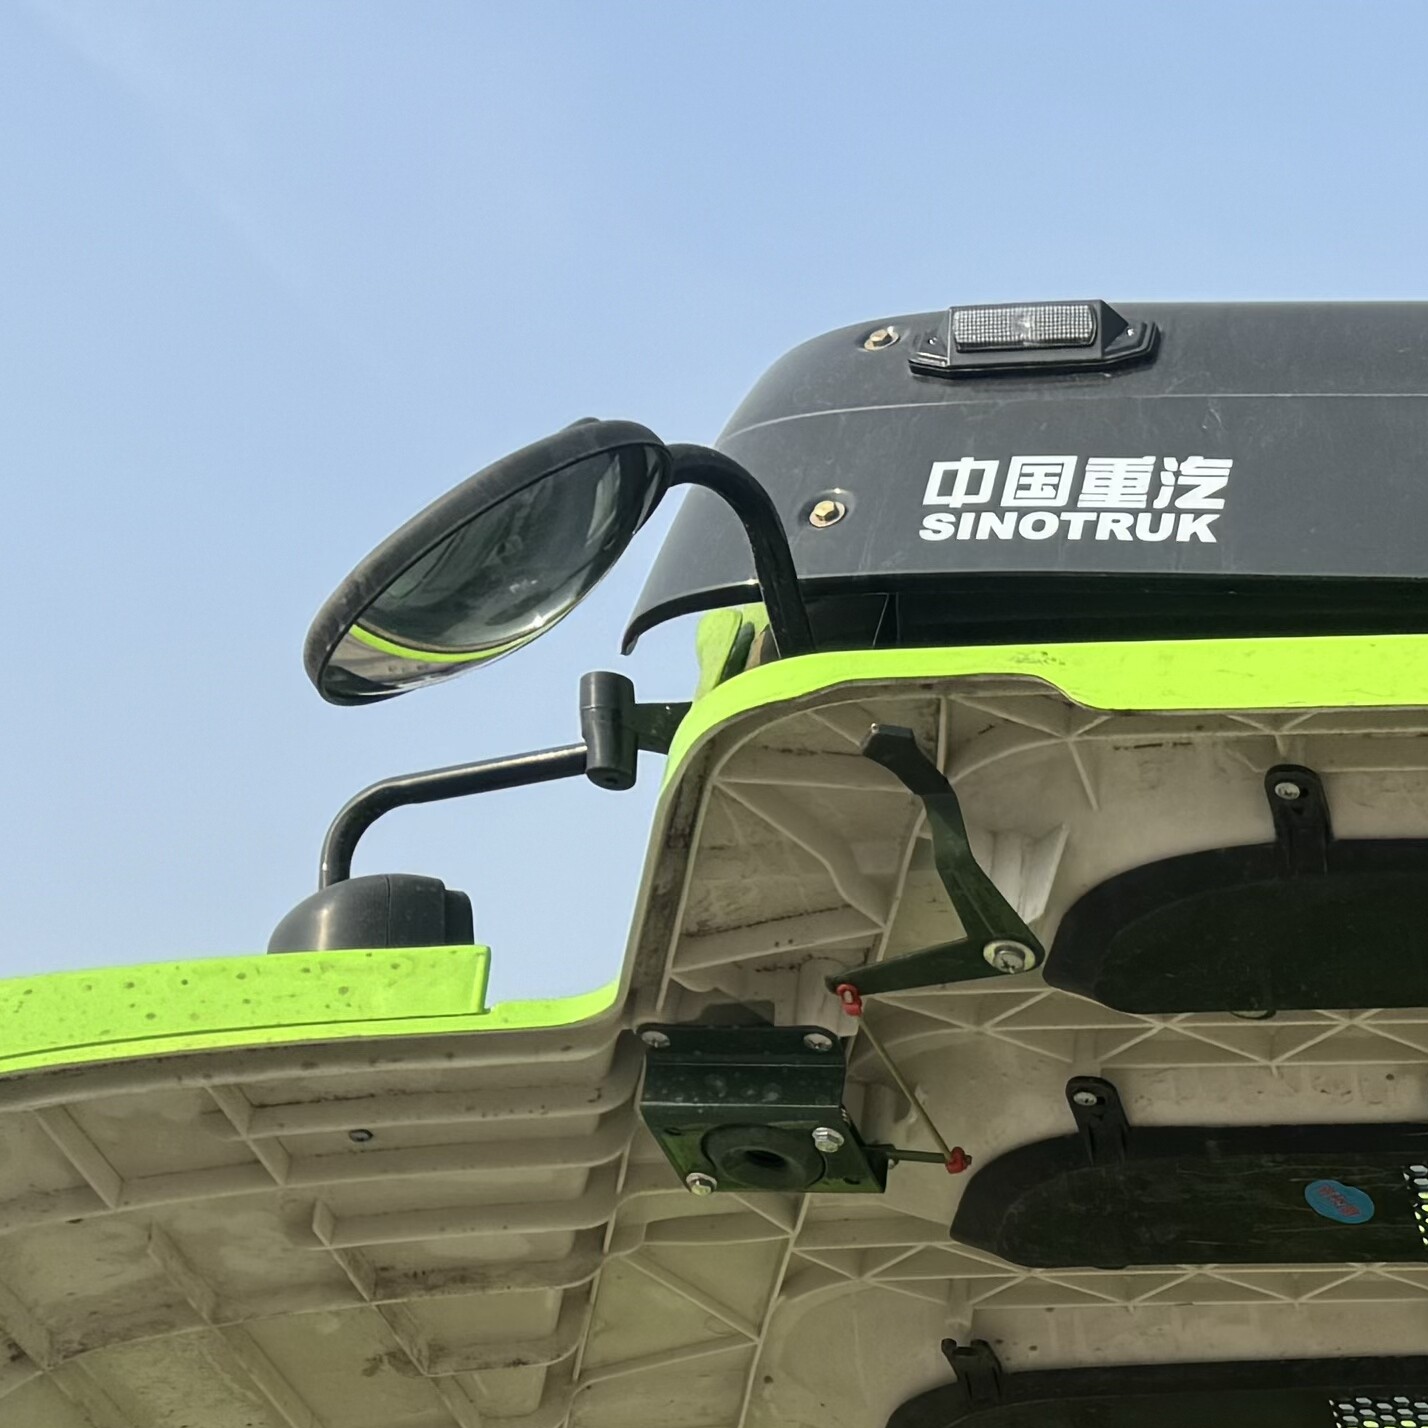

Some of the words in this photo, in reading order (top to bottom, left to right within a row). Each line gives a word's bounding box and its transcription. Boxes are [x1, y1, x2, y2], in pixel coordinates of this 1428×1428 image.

[922, 455, 1234, 510] 中国重汽
[918, 511, 1220, 543] SINOTRUK
